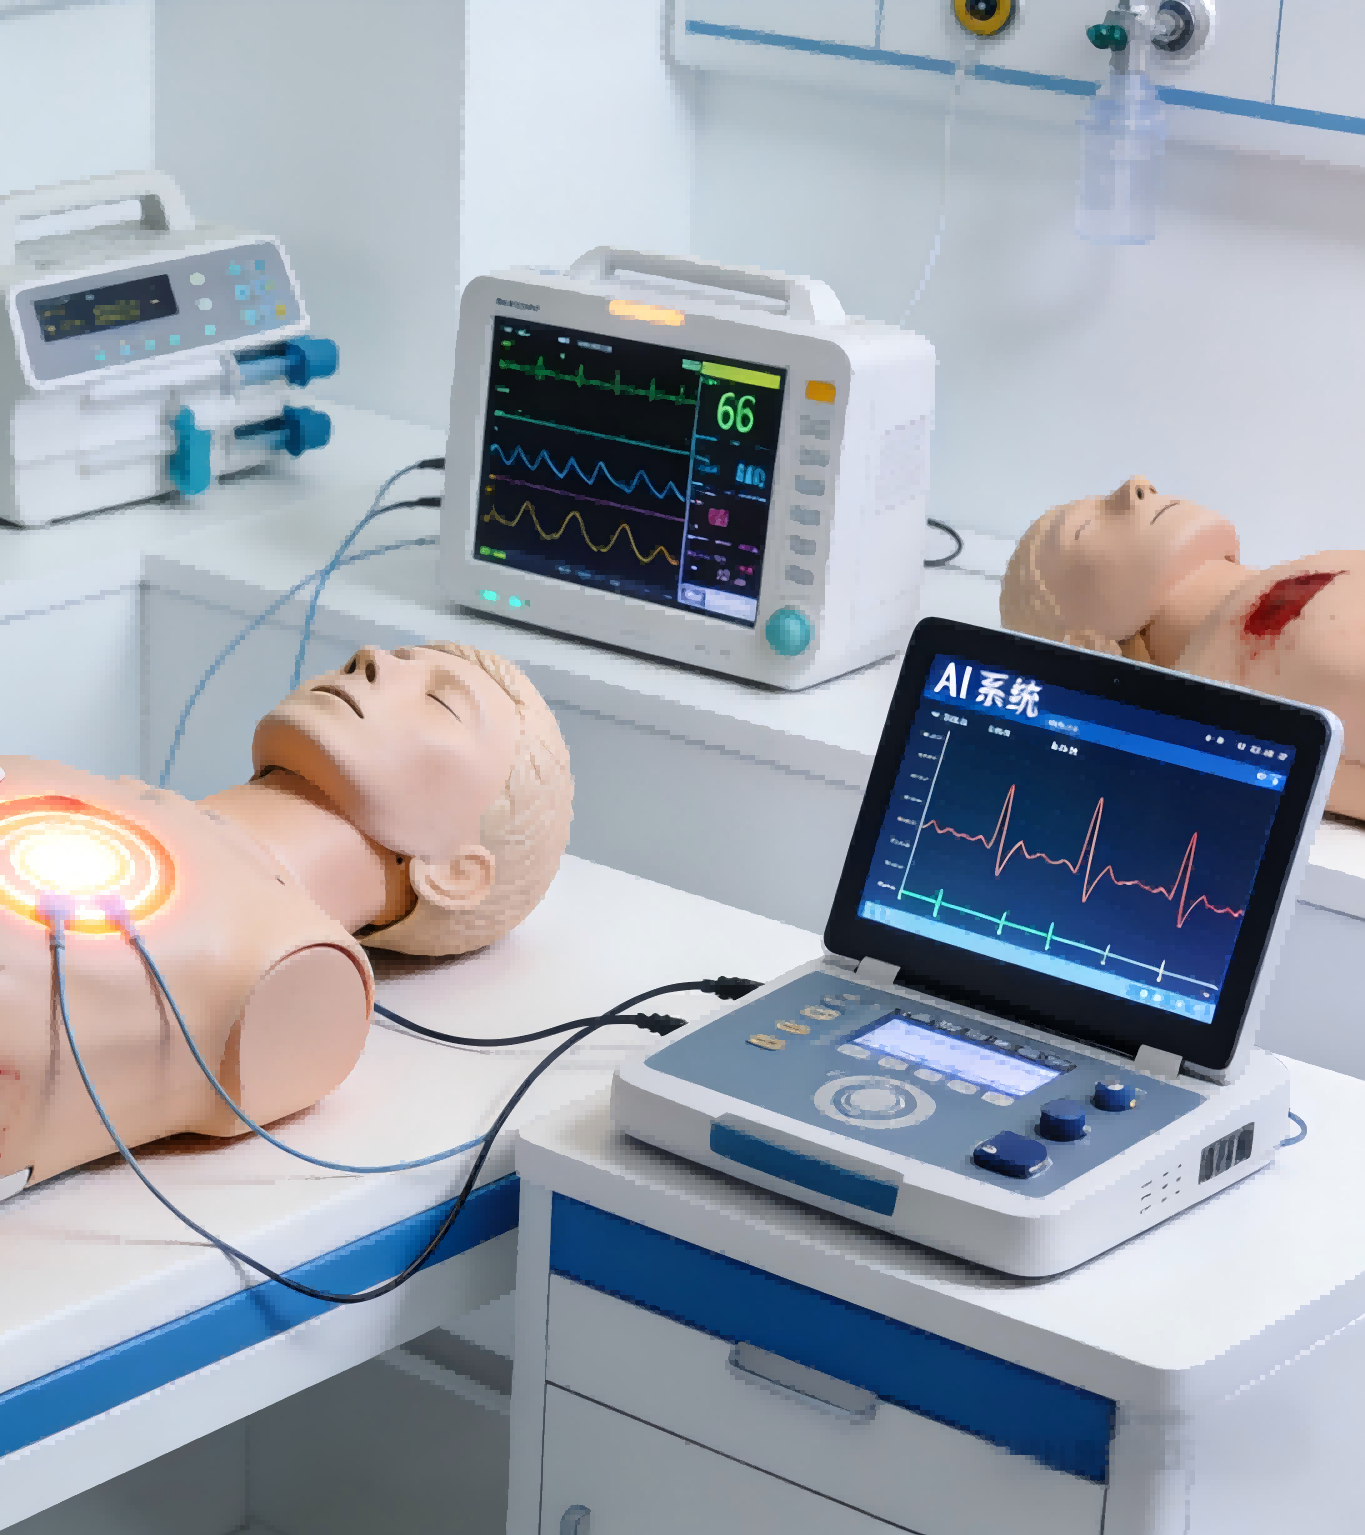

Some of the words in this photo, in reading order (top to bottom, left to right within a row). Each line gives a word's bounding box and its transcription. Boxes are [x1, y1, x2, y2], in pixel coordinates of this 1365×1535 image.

[717, 392, 756, 433] 66
[934, 662, 973, 699] AI
[975, 670, 1043, 718] 系统
